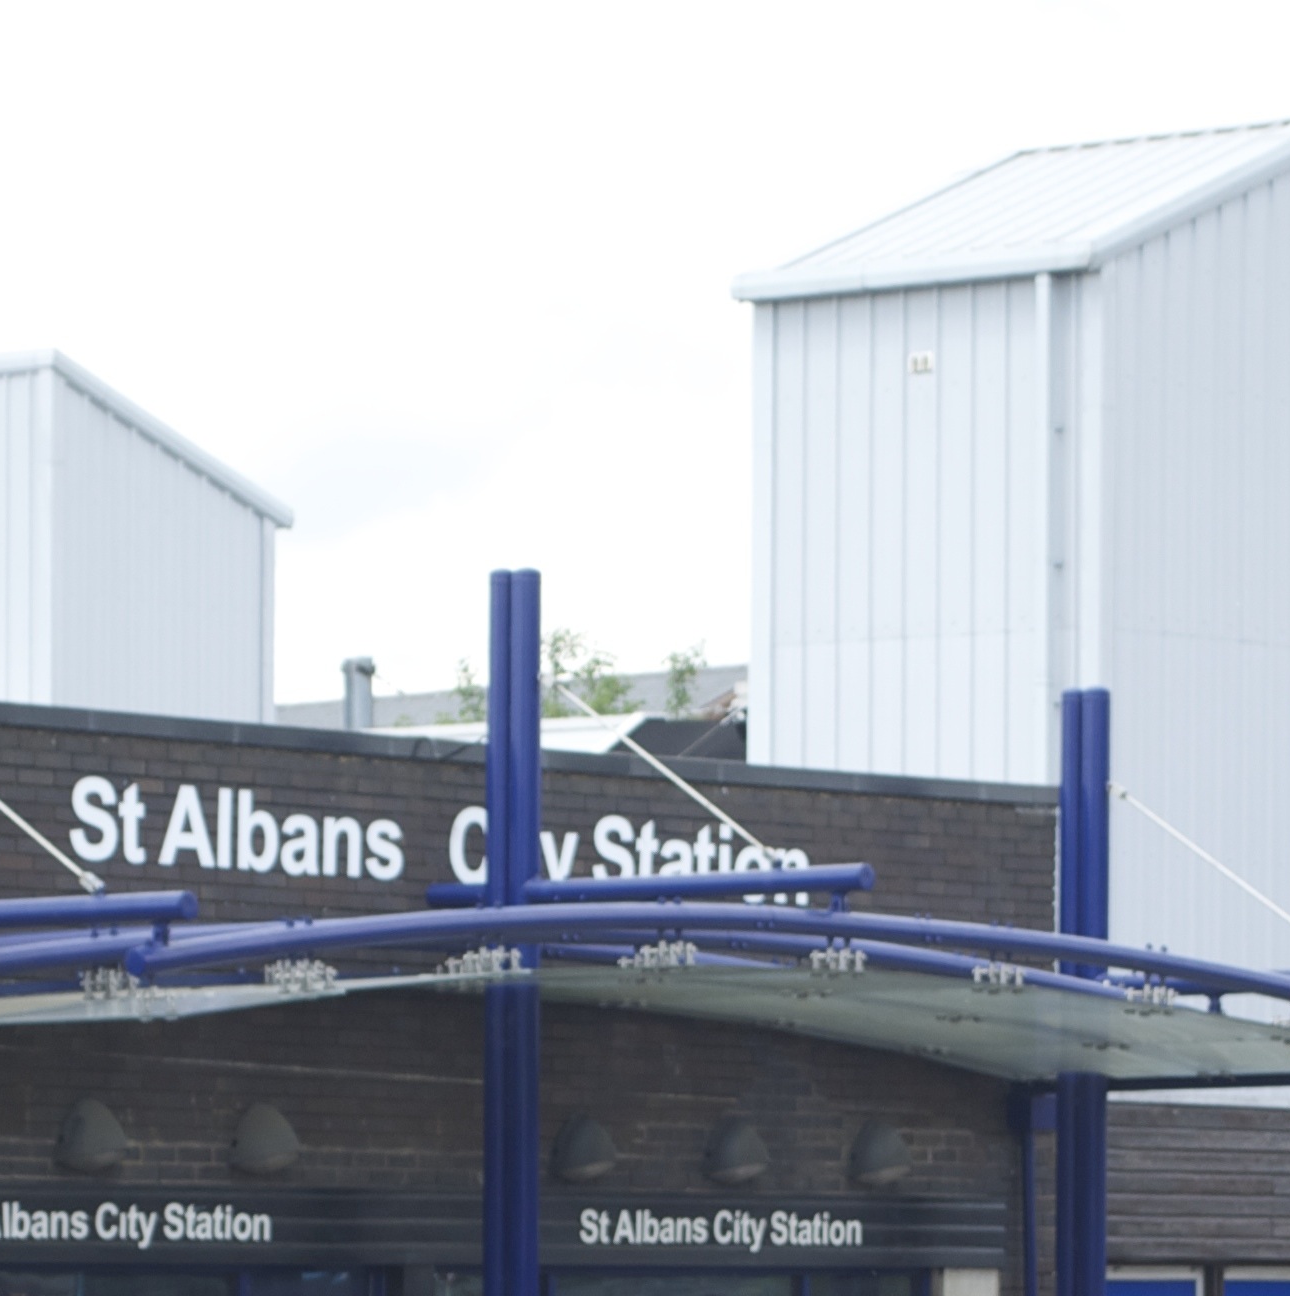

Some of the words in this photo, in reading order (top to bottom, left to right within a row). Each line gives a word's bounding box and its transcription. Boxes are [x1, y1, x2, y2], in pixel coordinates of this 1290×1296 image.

[69, 775, 147, 865] St
[158, 783, 406, 881] Albans
[448, 805, 579, 887] Cy
[591, 813, 811, 905] Station
[95, 1201, 157, 1249] City
[163, 1202, 273, 1242] Station
[579, 1208, 610, 1244] St
[612, 1208, 709, 1244] Albans
[713, 1209, 766, 1253] City
[770, 1210, 863, 1246] Station
